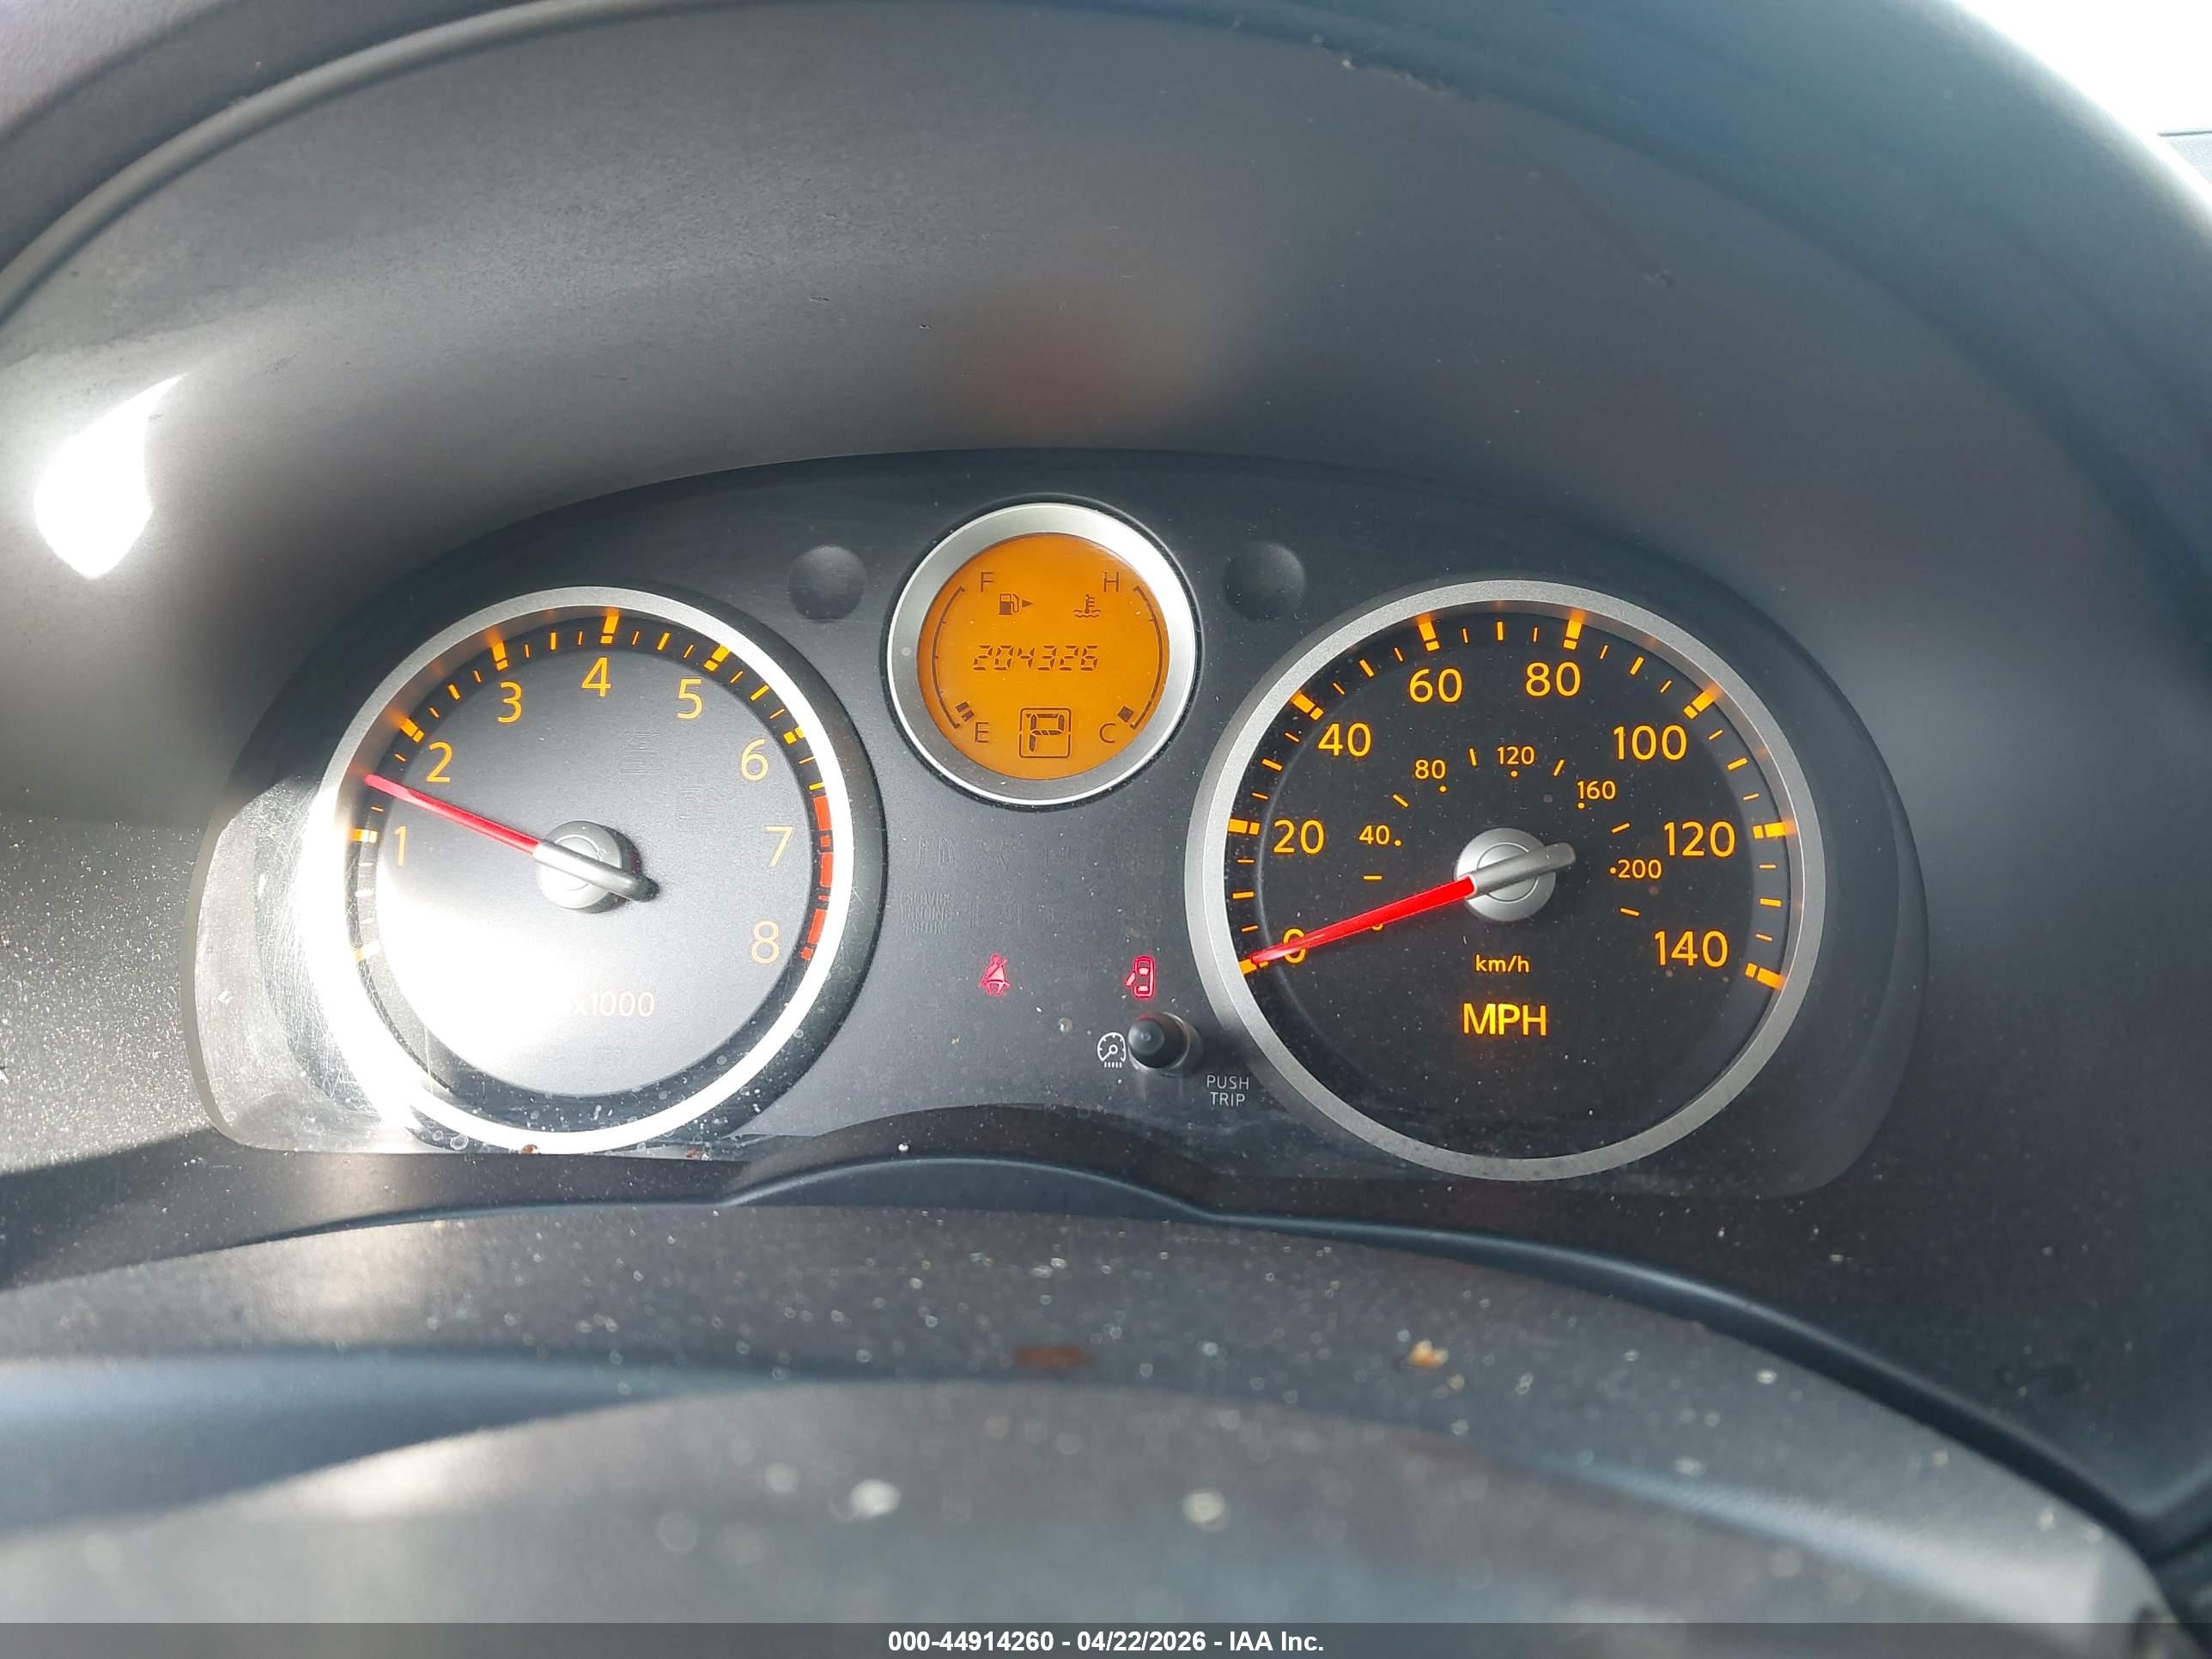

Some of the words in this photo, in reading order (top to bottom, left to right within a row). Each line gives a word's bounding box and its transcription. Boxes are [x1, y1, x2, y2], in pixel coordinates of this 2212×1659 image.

[980, 571, 995, 592] F
[1104, 572, 1119, 592] H
[974, 646, 1097, 671] 204326
[582, 658, 610, 696] 4
[1410, 669, 1462, 702] 60
[1526, 662, 1580, 696] 80
[499, 682, 522, 723] 3
[678, 678, 702, 719] 5
[975, 722, 988, 743] E
[1026, 714, 1064, 751] P
[1100, 724, 1115, 743] C
[1317, 724, 1371, 757] 40
[1614, 726, 1686, 760] 100
[427, 742, 453, 782] 2
[740, 738, 769, 781] 6
[1415, 760, 1445, 779] 80
[1498, 746, 1534, 764] 120
[1577, 781, 1615, 799] 160
[395, 825, 407, 865] 1
[766, 826, 793, 866] 7
[1273, 820, 1324, 854] 20
[1359, 825, 1389, 844] 40
[1664, 822, 1735, 857] 120
[1619, 860, 1662, 878] 200
[751, 921, 780, 963] 8
[1655, 931, 1728, 967] 140
[1476, 956, 1528, 972] km/h
[1463, 1003, 1547, 1036] MPH
[1207, 1075, 1249, 1089] PUSH
[1210, 1092, 1244, 1106] TRIP
